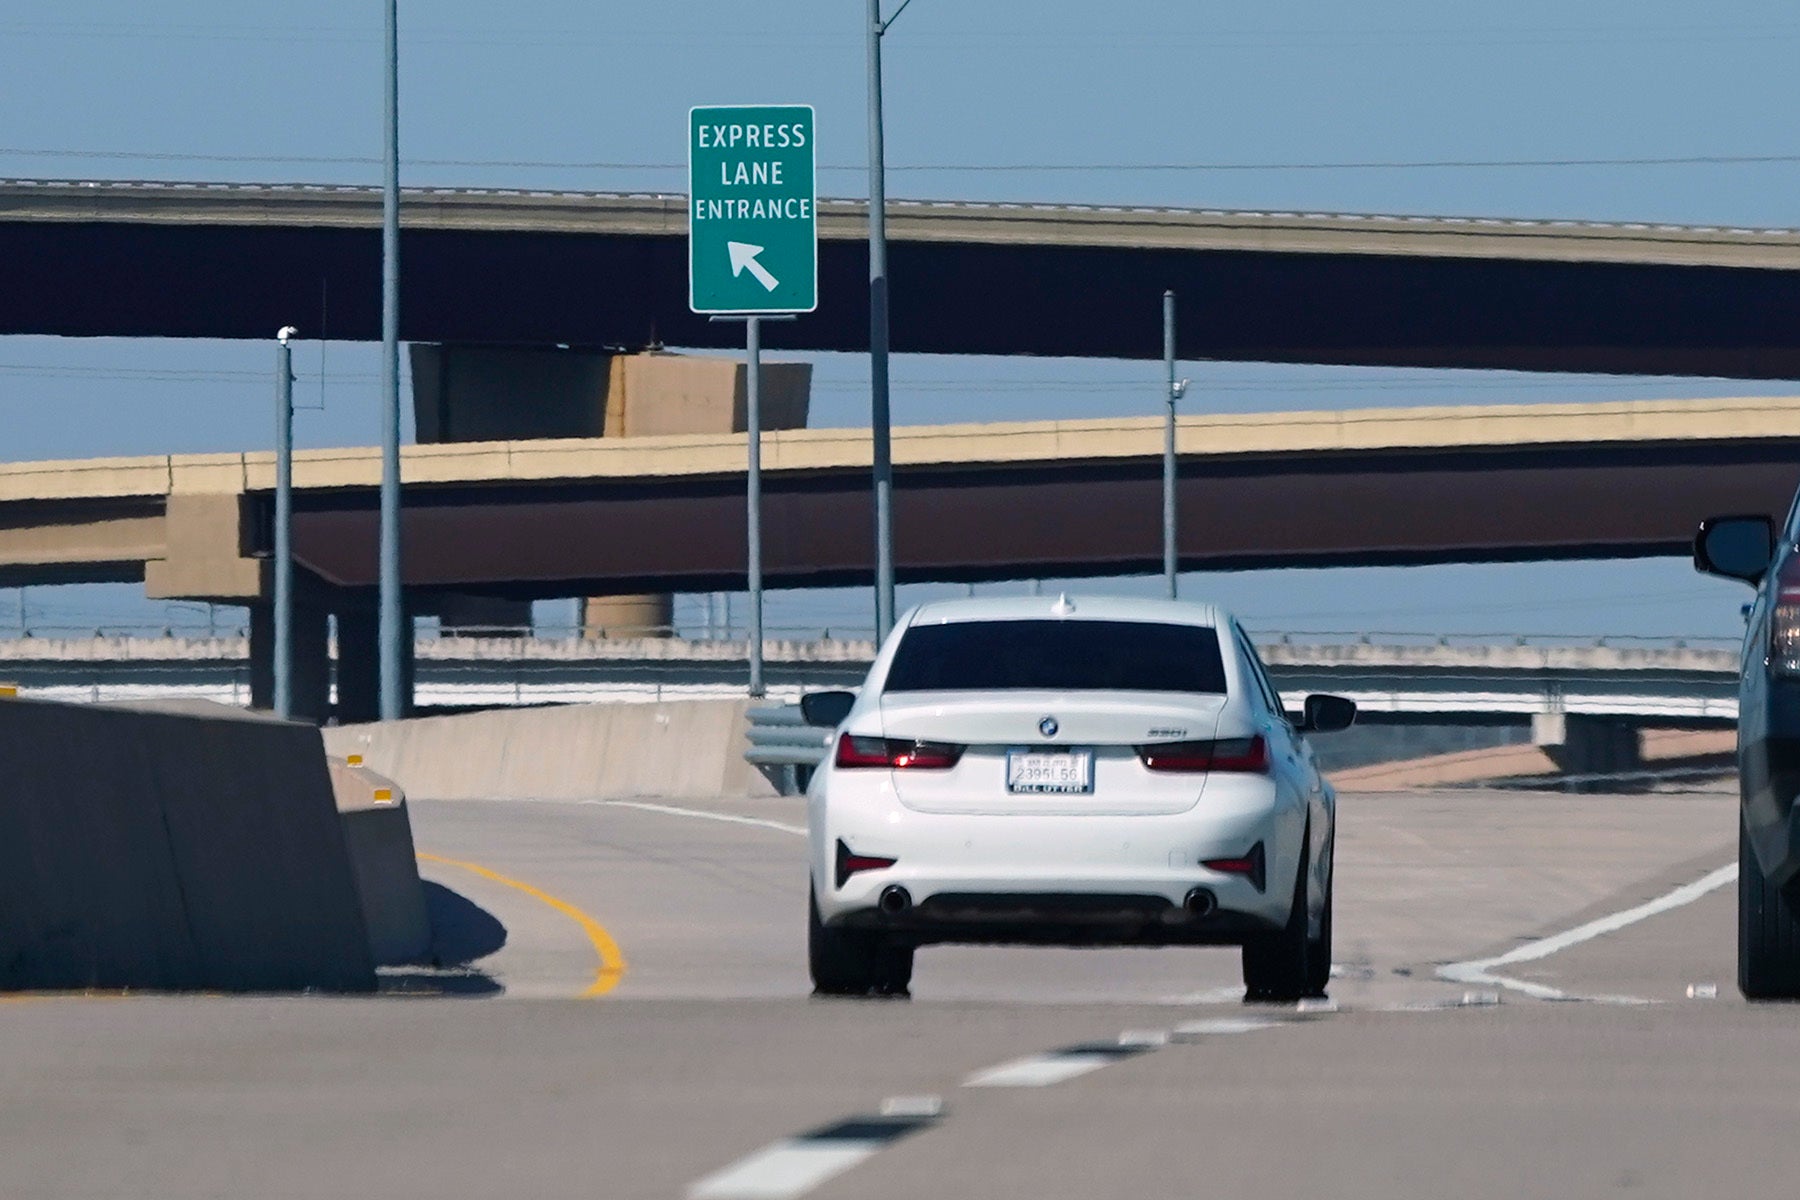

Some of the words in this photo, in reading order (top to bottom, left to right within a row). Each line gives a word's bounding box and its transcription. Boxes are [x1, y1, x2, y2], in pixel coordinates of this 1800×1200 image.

[698, 123, 806, 148] EXPRESS
[721, 161, 783, 186] LANE
[695, 198, 810, 219] ENTRANCE
